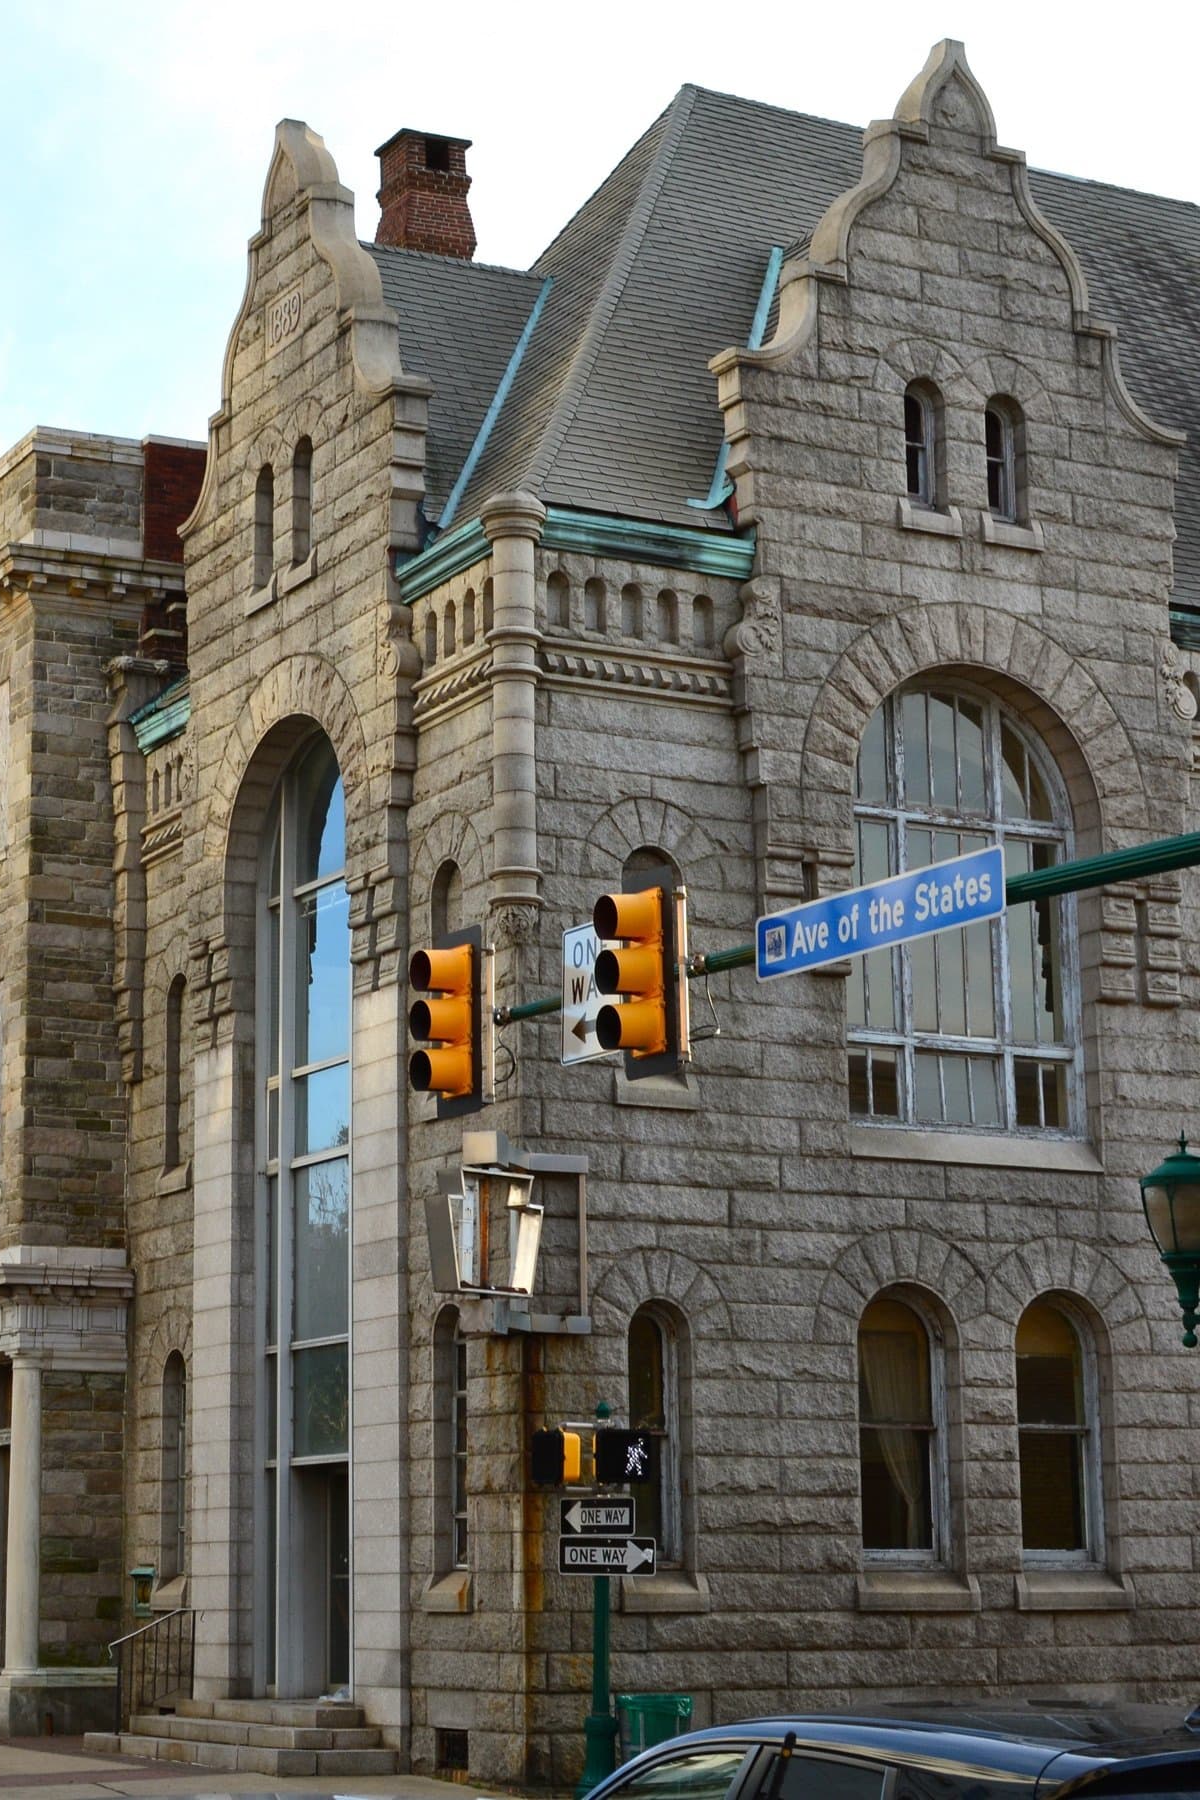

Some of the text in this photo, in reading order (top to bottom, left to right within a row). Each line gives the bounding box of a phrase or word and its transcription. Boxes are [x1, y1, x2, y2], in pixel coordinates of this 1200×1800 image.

[270, 291, 301, 348] 1889
[791, 873, 992, 957] Ave of the States
[571, 973, 598, 1005] WA
[580, 1508, 626, 1523] ONE WAY
[569, 1548, 627, 1563] ONE WAY
